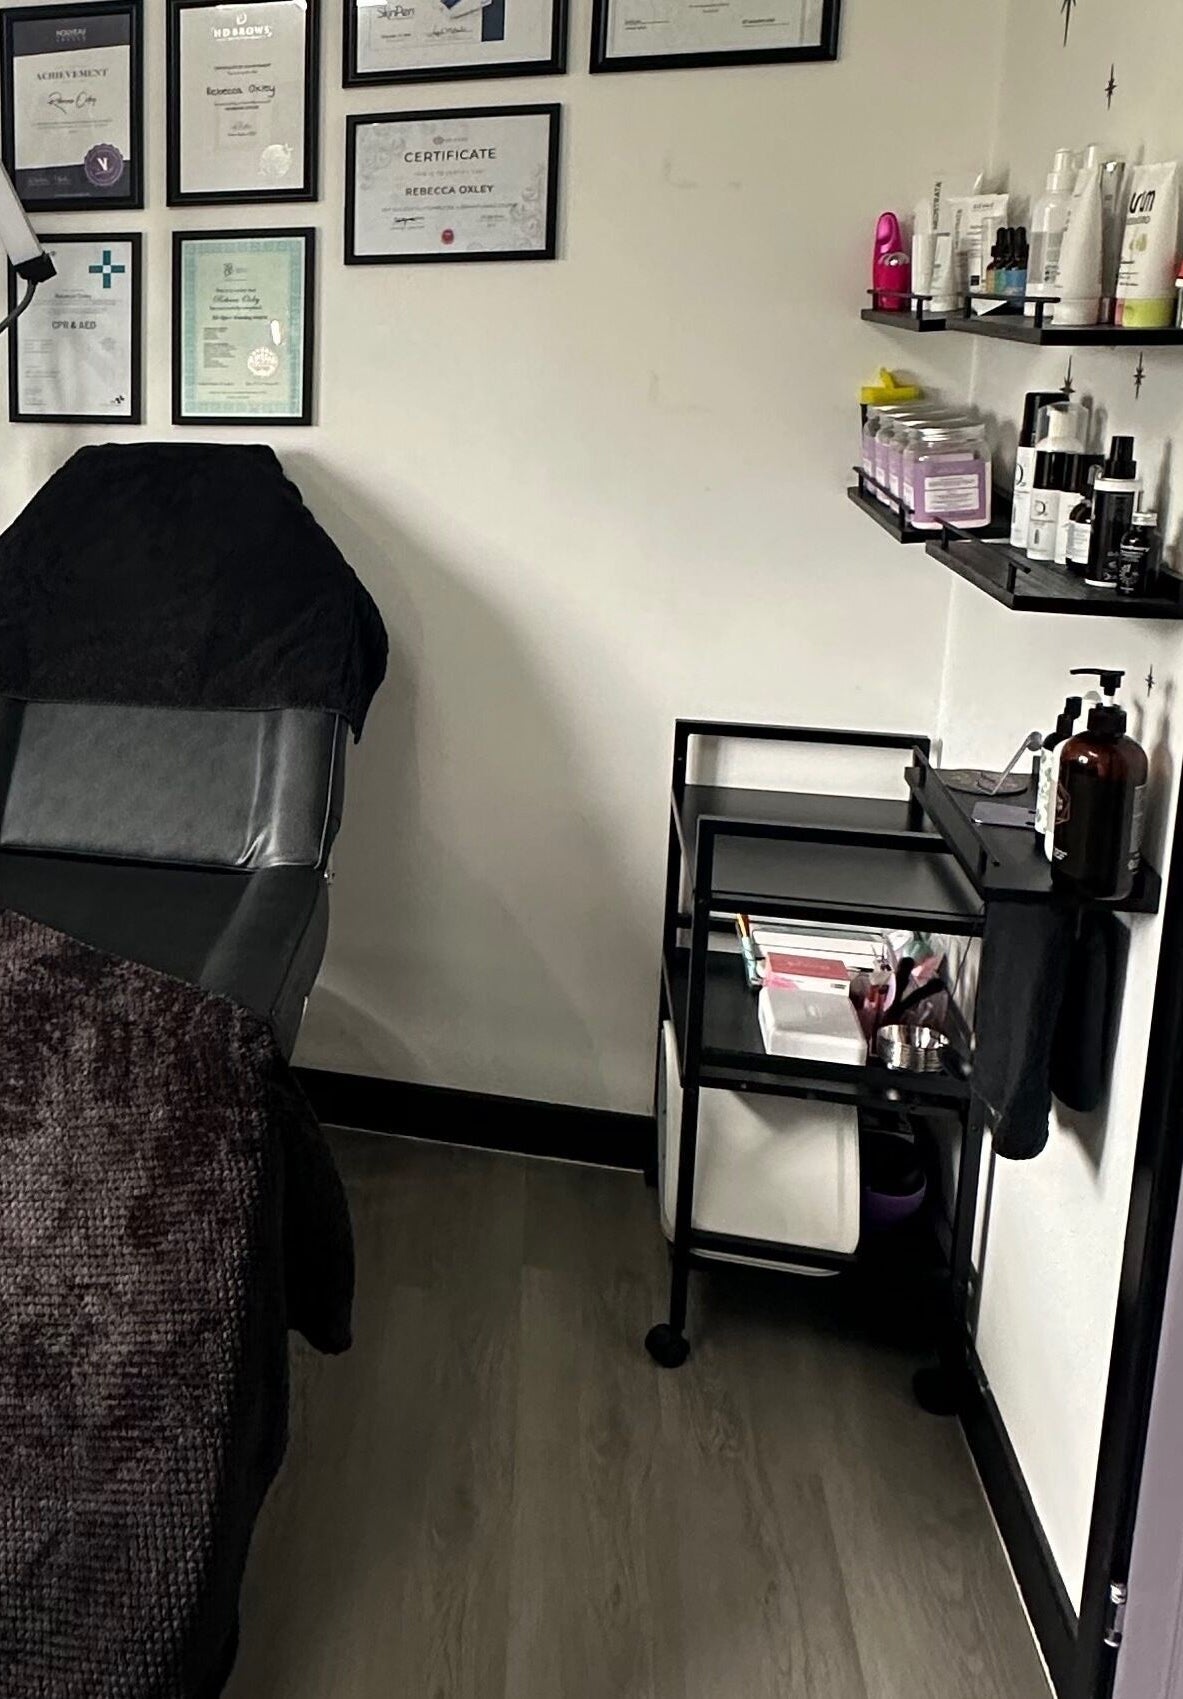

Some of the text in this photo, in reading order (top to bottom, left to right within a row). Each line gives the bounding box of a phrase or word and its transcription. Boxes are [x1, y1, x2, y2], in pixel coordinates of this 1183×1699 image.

[37, 68, 109, 80] ACHIEVEMENT
[404, 148, 497, 163] CERTIFICATE
[405, 184, 495, 196] REBECCA OXLEY
